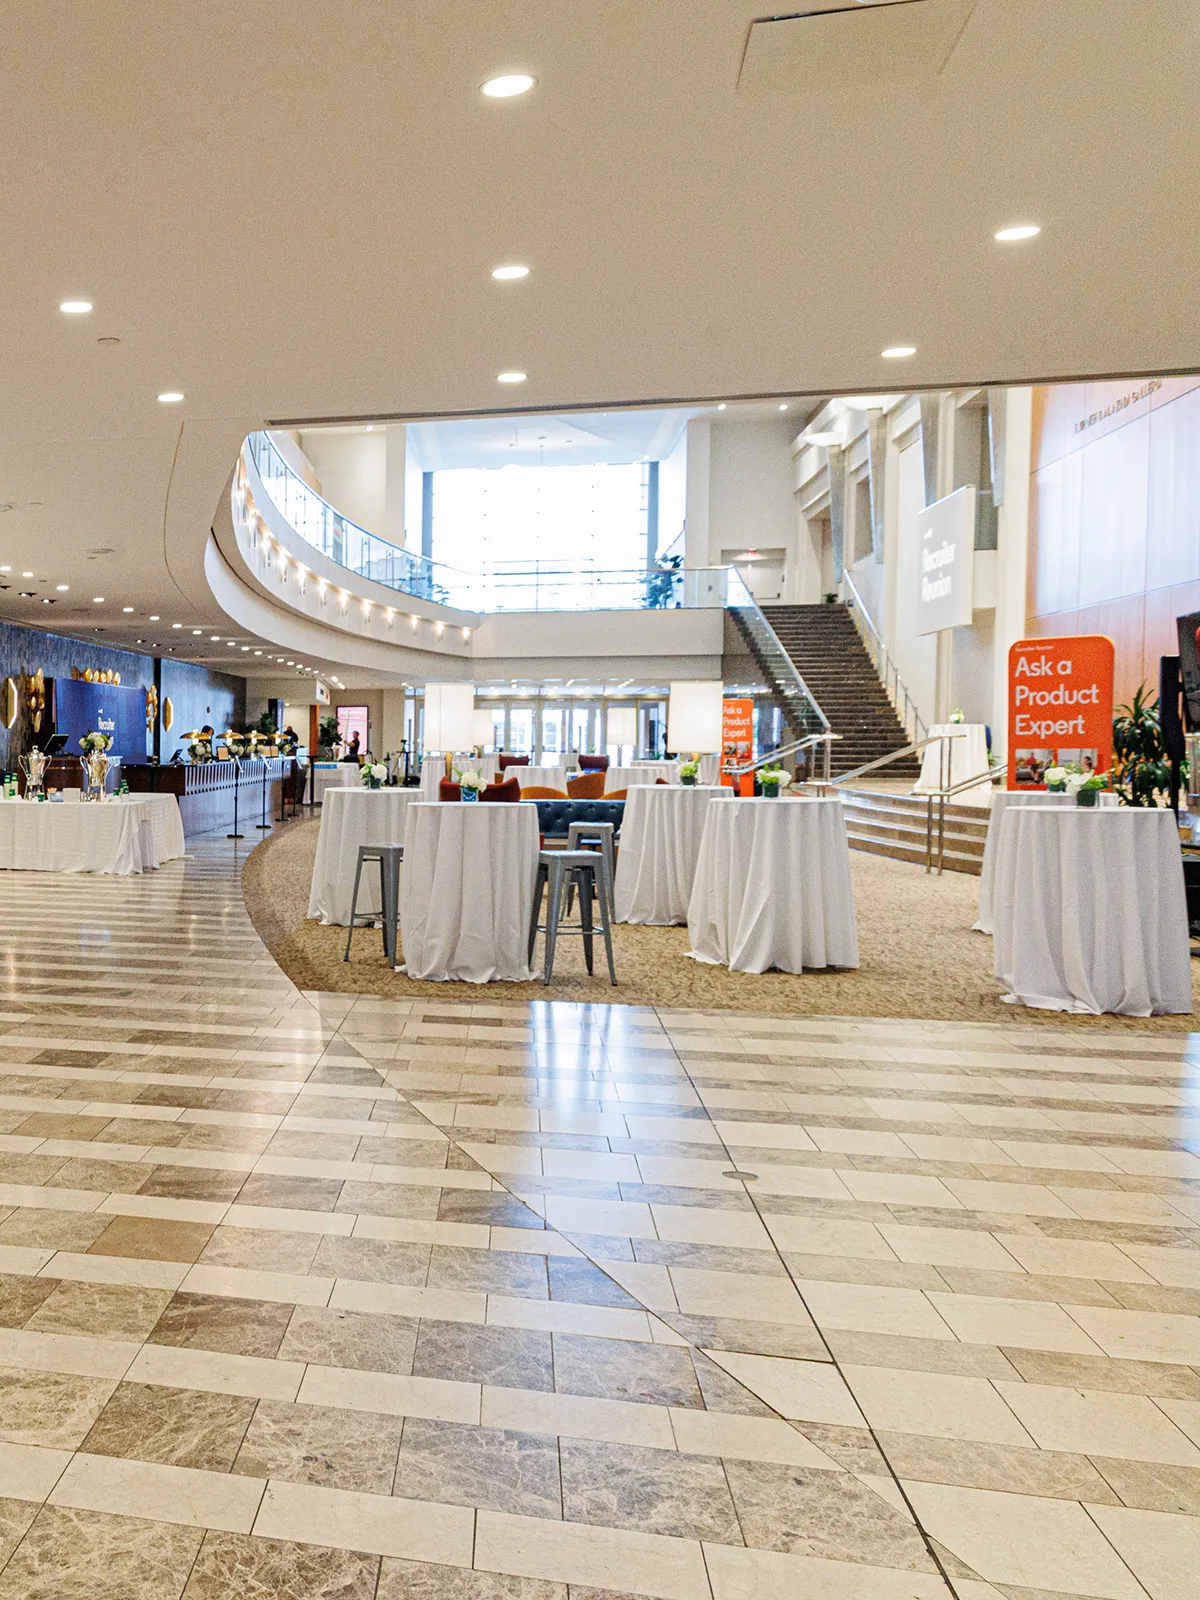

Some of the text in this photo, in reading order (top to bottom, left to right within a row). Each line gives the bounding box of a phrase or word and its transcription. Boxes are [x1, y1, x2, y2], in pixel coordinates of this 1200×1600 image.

[1014, 654, 1073, 678] Ask a
[1015, 683, 1100, 707] Product
[723, 705, 735, 714] Ask
[723, 717, 750, 726] Product
[1015, 714, 1086, 739] Expert
[723, 728, 747, 739] Expert
